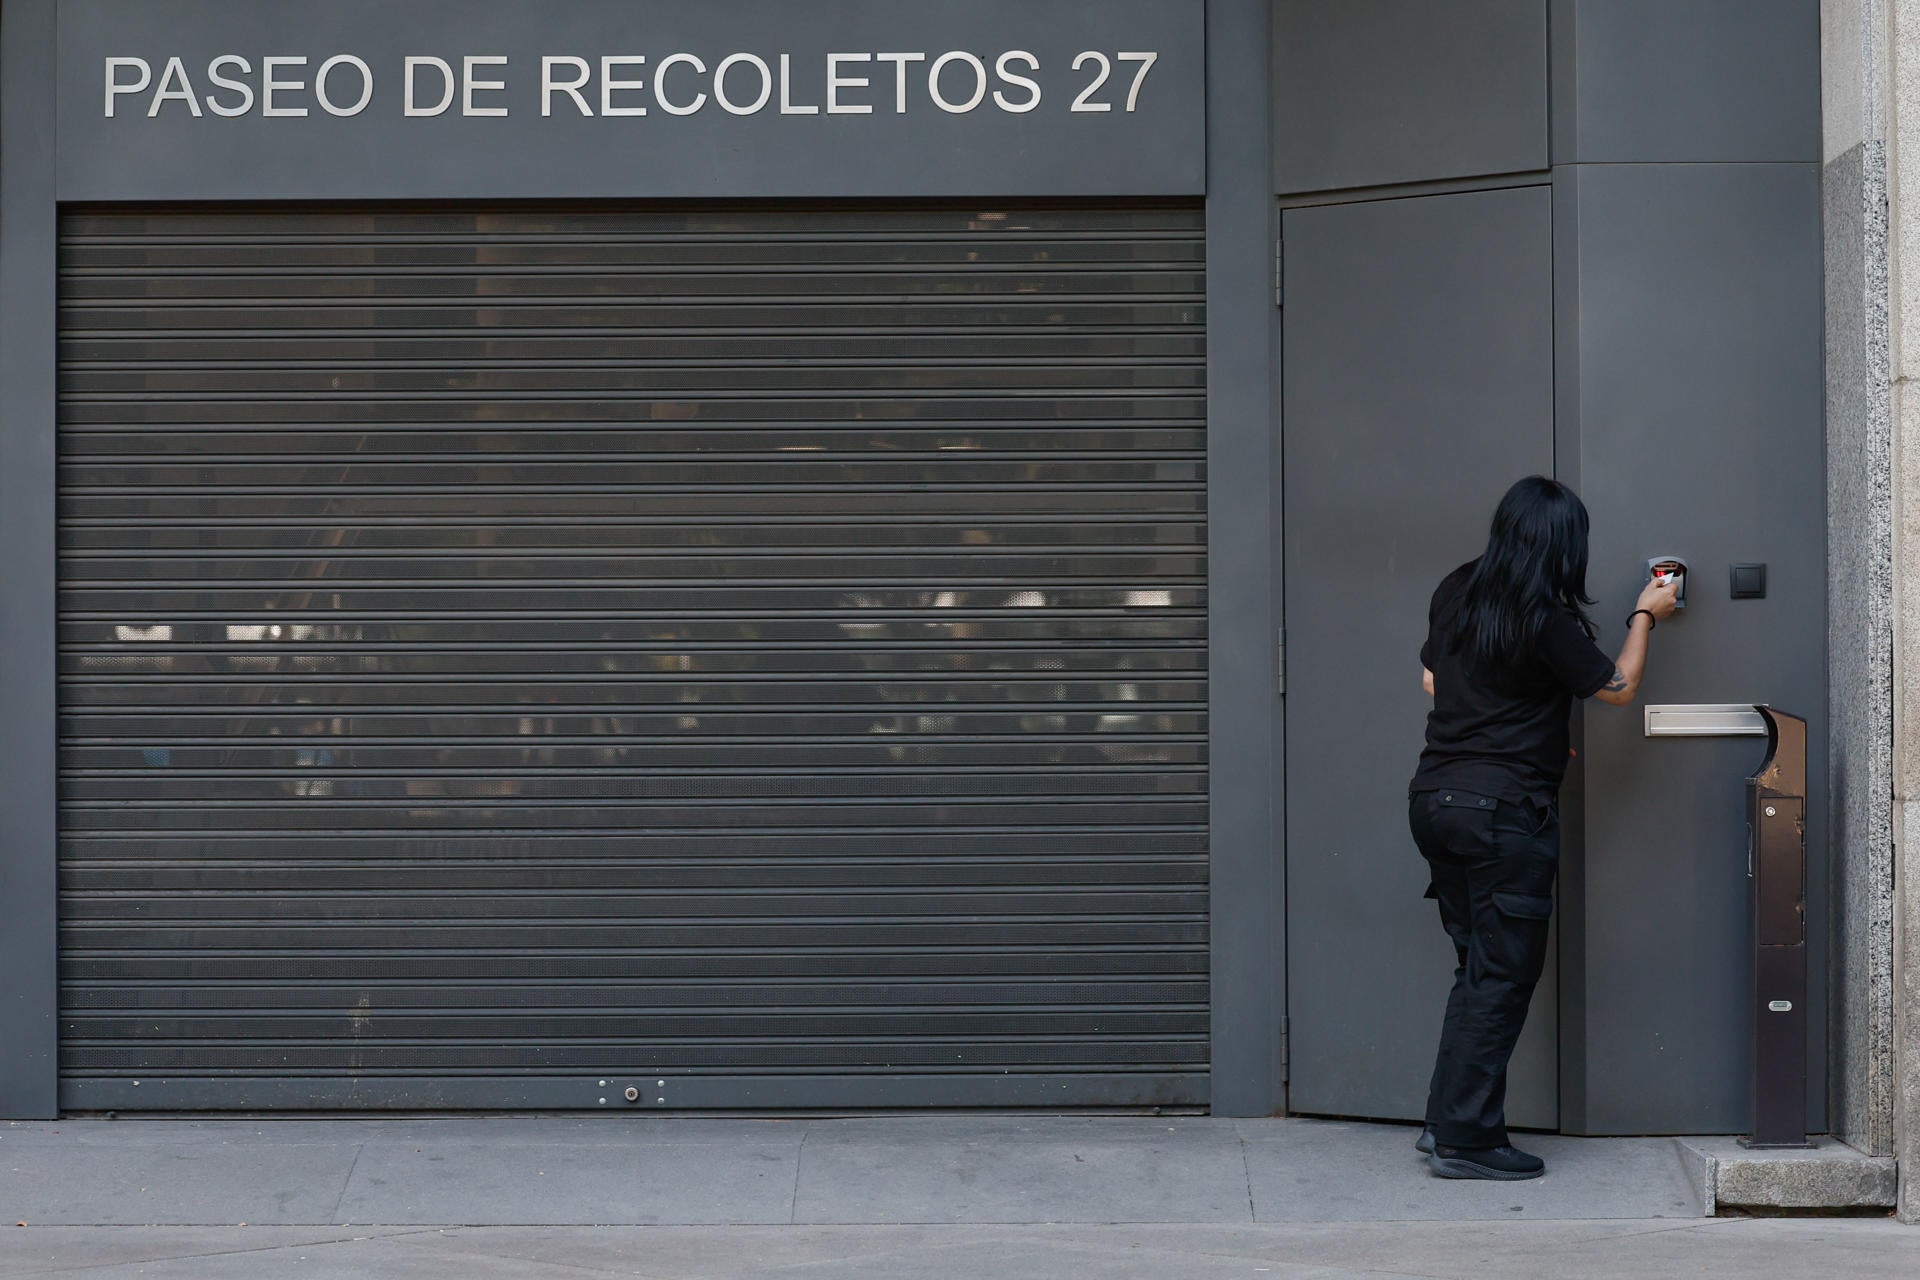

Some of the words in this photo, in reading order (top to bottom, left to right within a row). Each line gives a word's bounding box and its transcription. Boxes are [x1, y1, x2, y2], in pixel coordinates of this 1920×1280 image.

[104, 54, 373, 118] PASEO
[404, 55, 508, 117] DE
[541, 50, 1042, 118] RECOLETOS
[1070, 50, 1158, 113] 27
